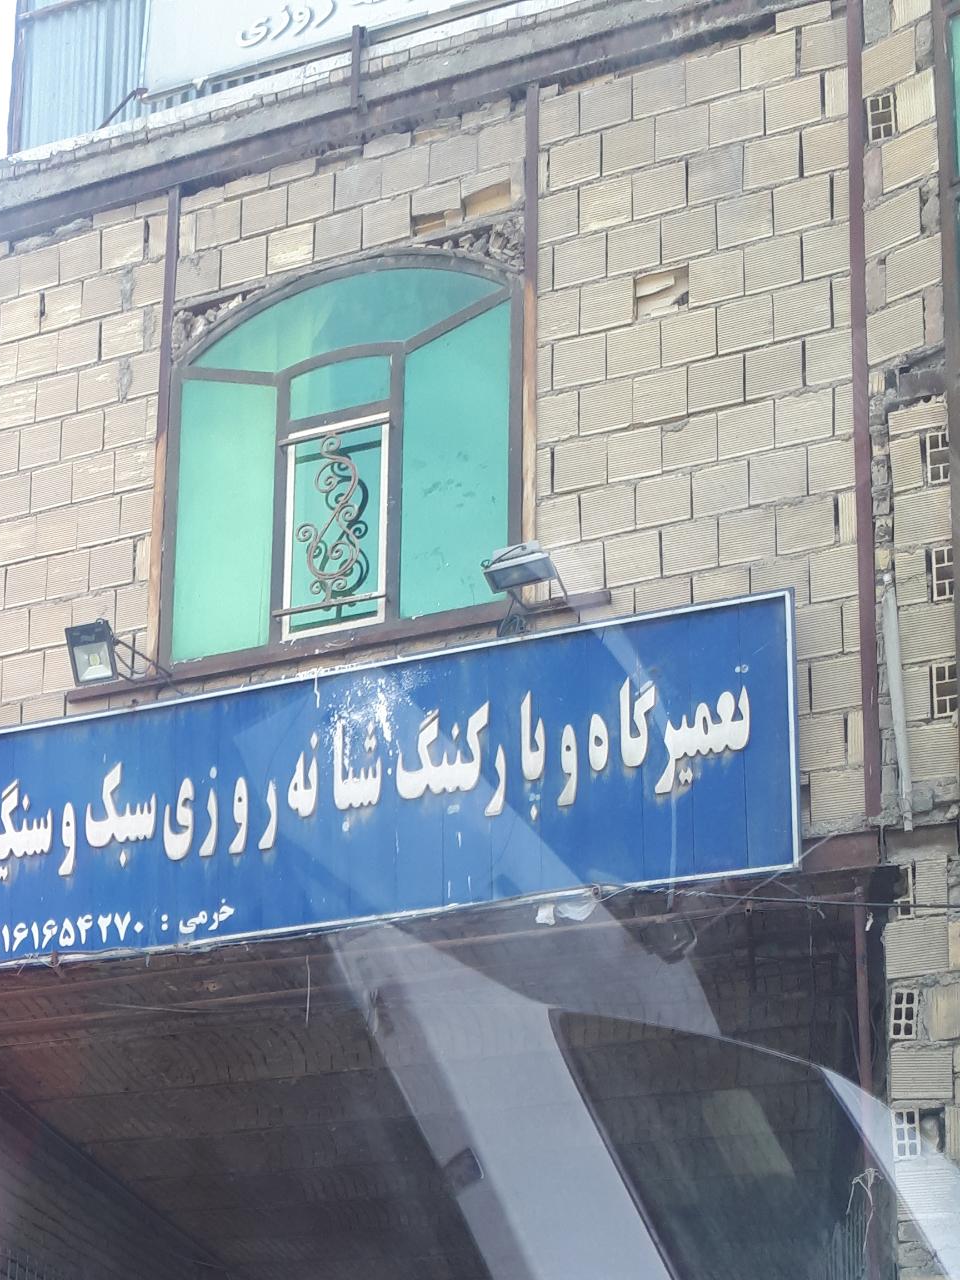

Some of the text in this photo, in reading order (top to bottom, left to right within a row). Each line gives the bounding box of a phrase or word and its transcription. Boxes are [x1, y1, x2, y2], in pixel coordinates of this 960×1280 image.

[396, 689, 546, 821] پارکینگ
[557, 723, 578, 806] و
[588, 664, 750, 794] تعمیرگاه
[58, 802, 77, 876] و
[85, 761, 157, 869] سبک
